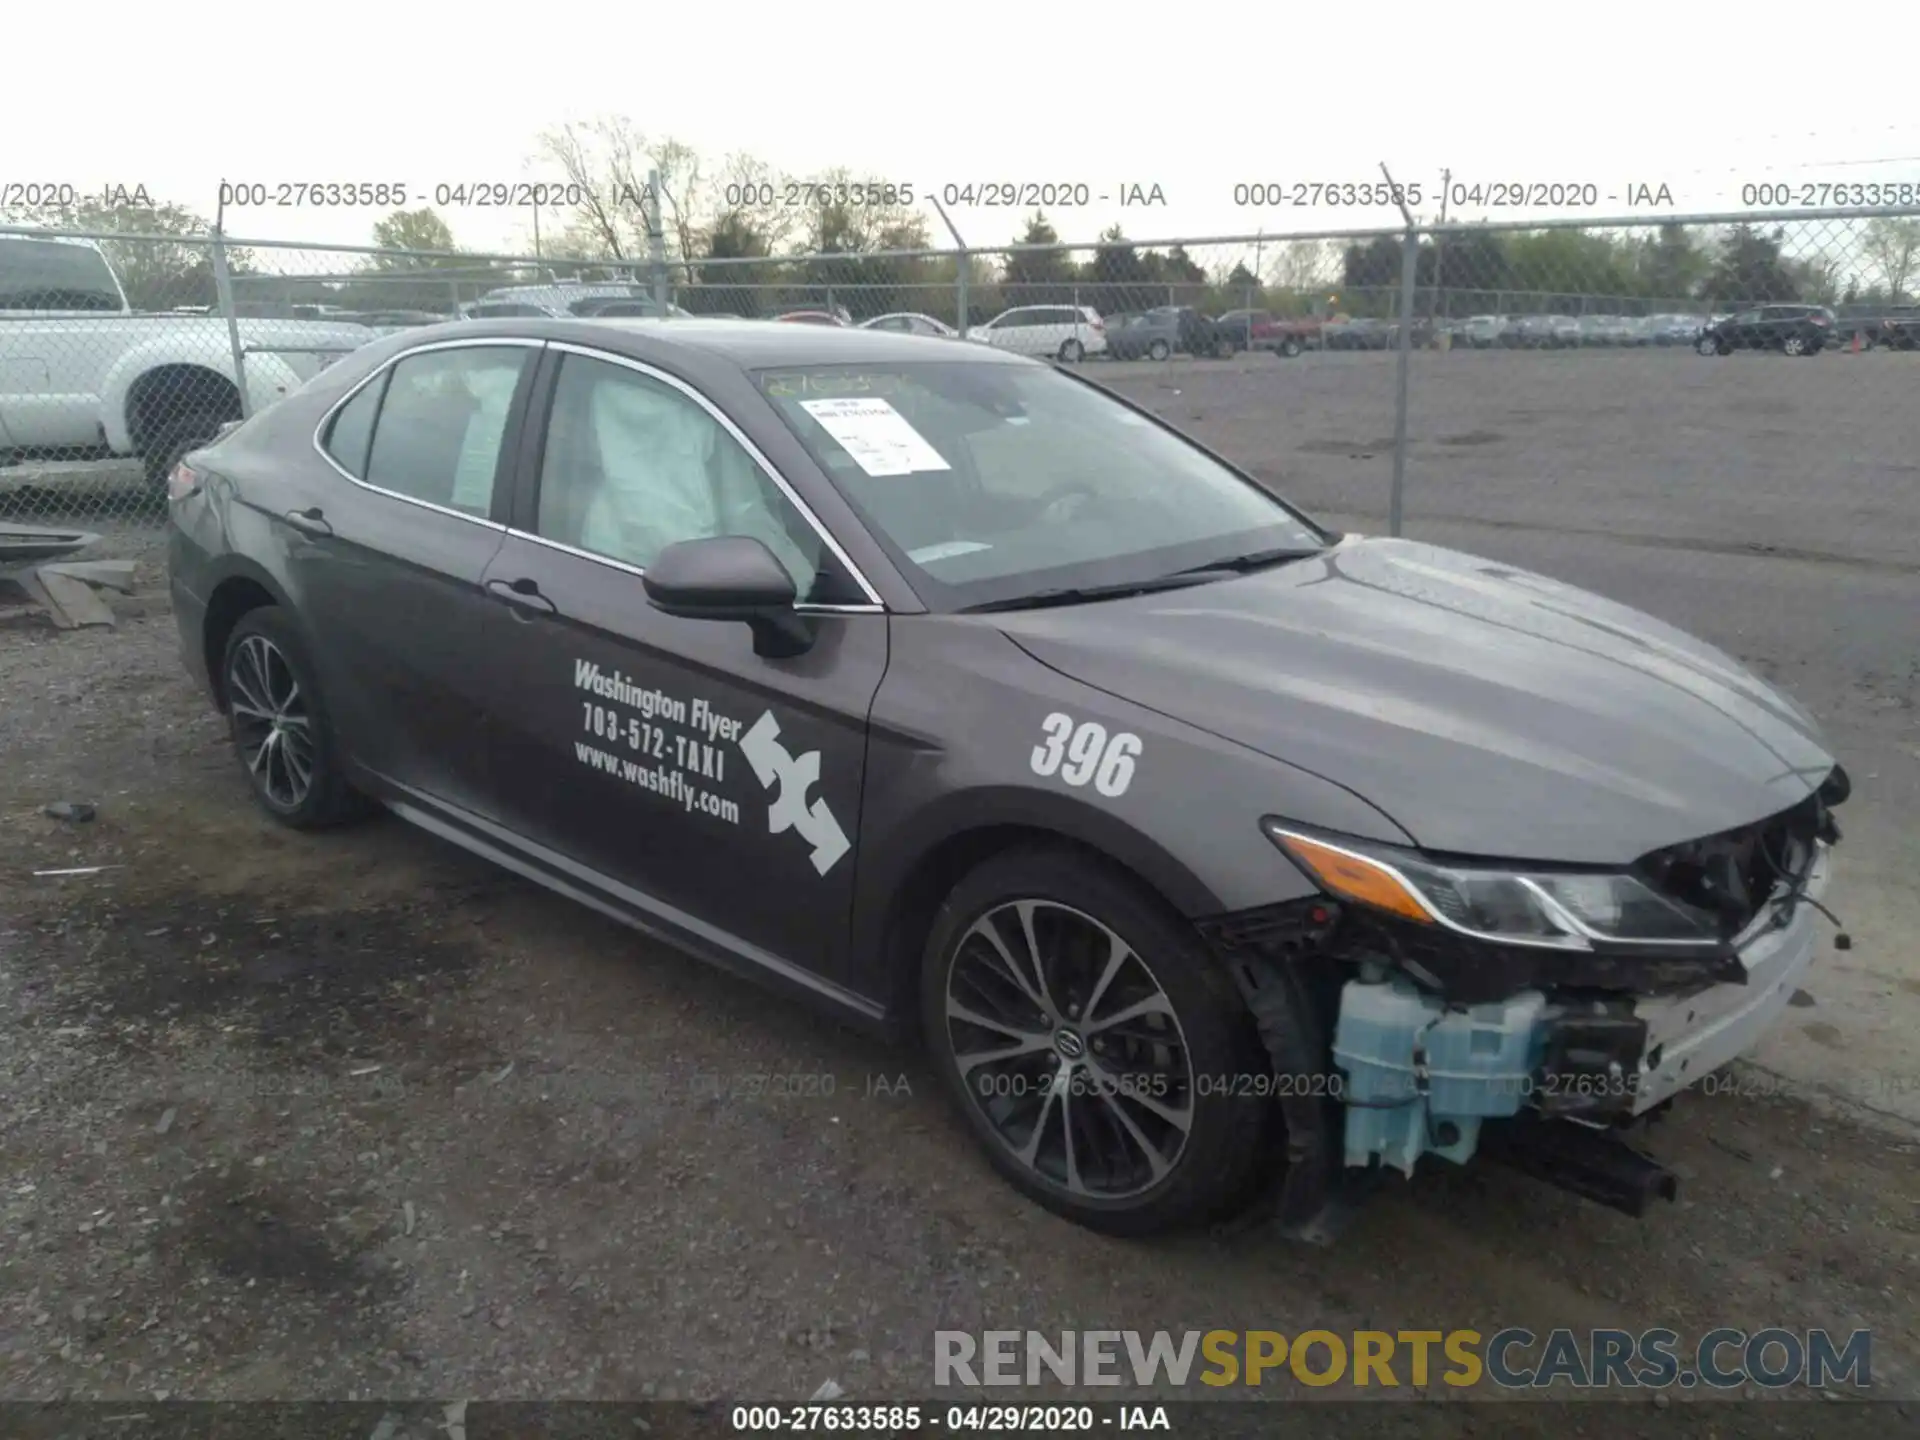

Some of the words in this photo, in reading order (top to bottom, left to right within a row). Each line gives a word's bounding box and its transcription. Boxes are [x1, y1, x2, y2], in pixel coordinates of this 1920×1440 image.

[574, 658, 686, 723] Washington
[691, 698, 742, 742] Flyer
[574, 741, 739, 824] www.washfly.com
[583, 702, 724, 782] 703-572-TAXI
[1030, 712, 1143, 797] 396
